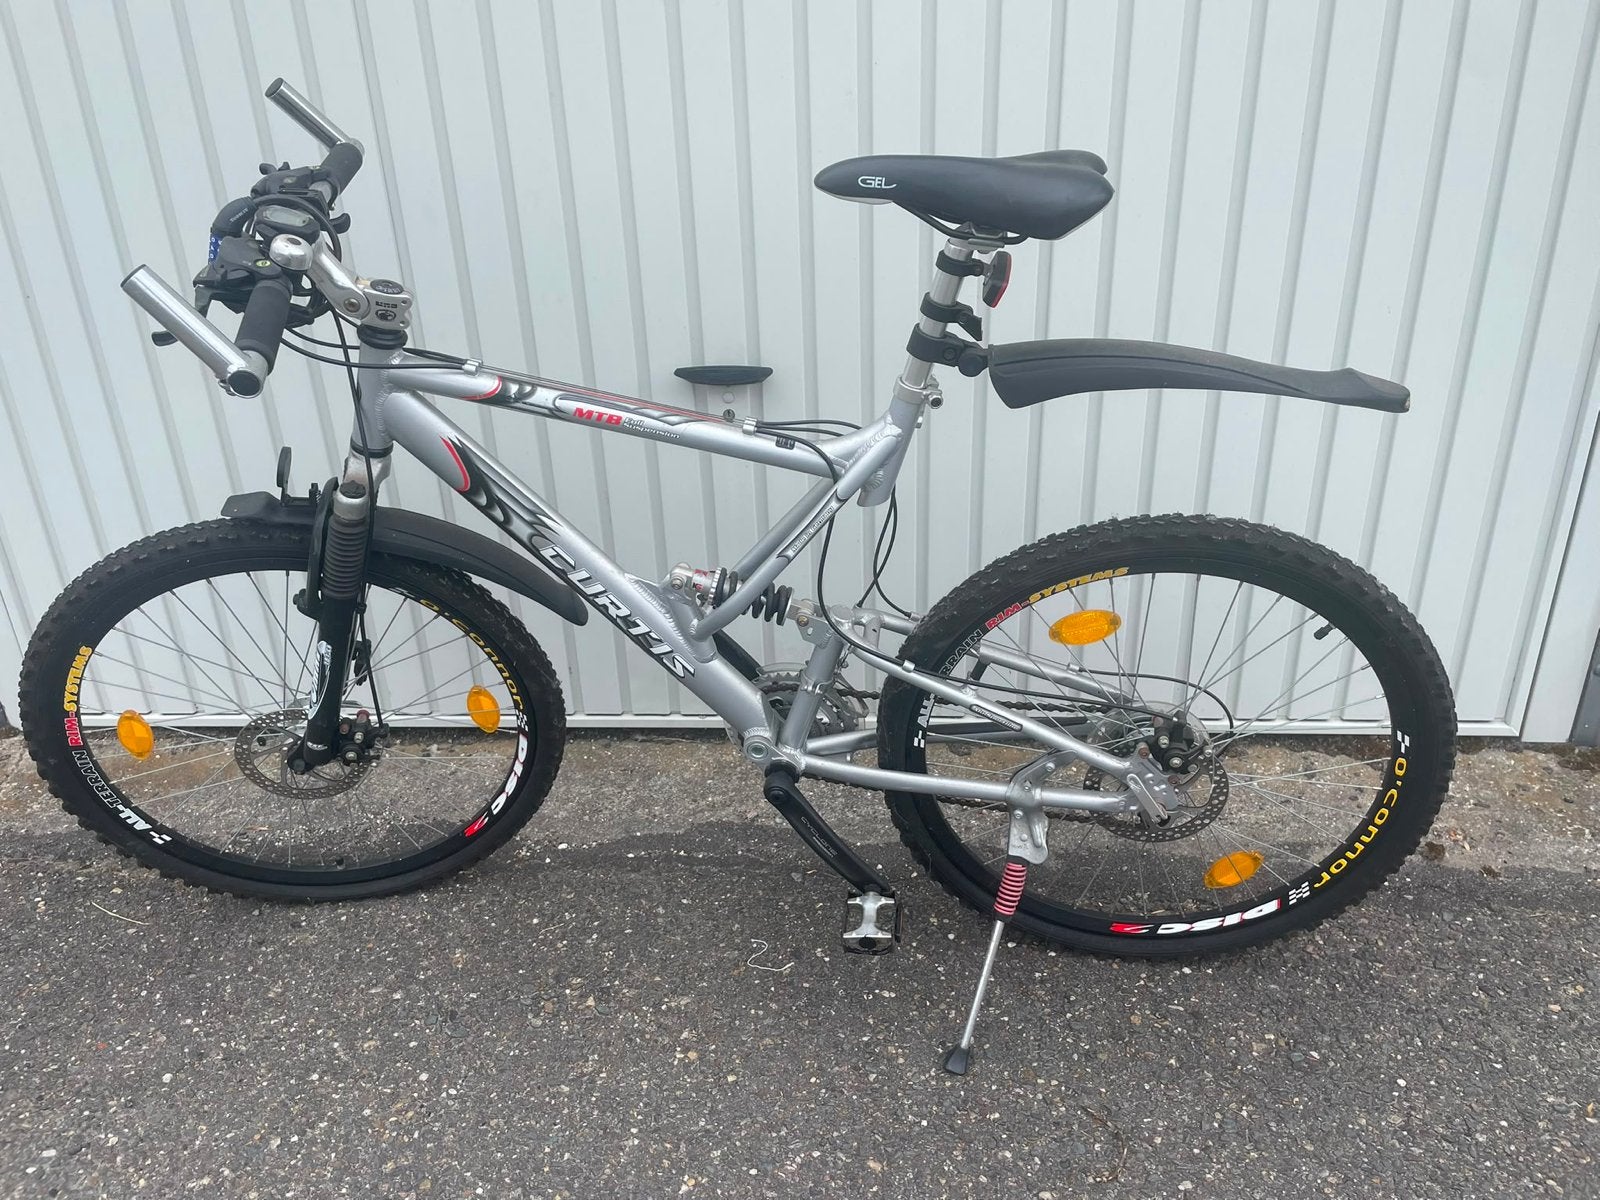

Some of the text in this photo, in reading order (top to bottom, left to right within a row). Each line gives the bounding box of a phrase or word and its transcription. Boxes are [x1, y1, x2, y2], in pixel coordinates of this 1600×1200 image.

[858, 175, 897, 188] GEL
[572, 407, 623, 426] MTB
[623, 416, 646, 427] Full
[623, 422, 680, 439] Suspension
[539, 544, 695, 677] CURTIS
[1156, 898, 1282, 935] DISC
